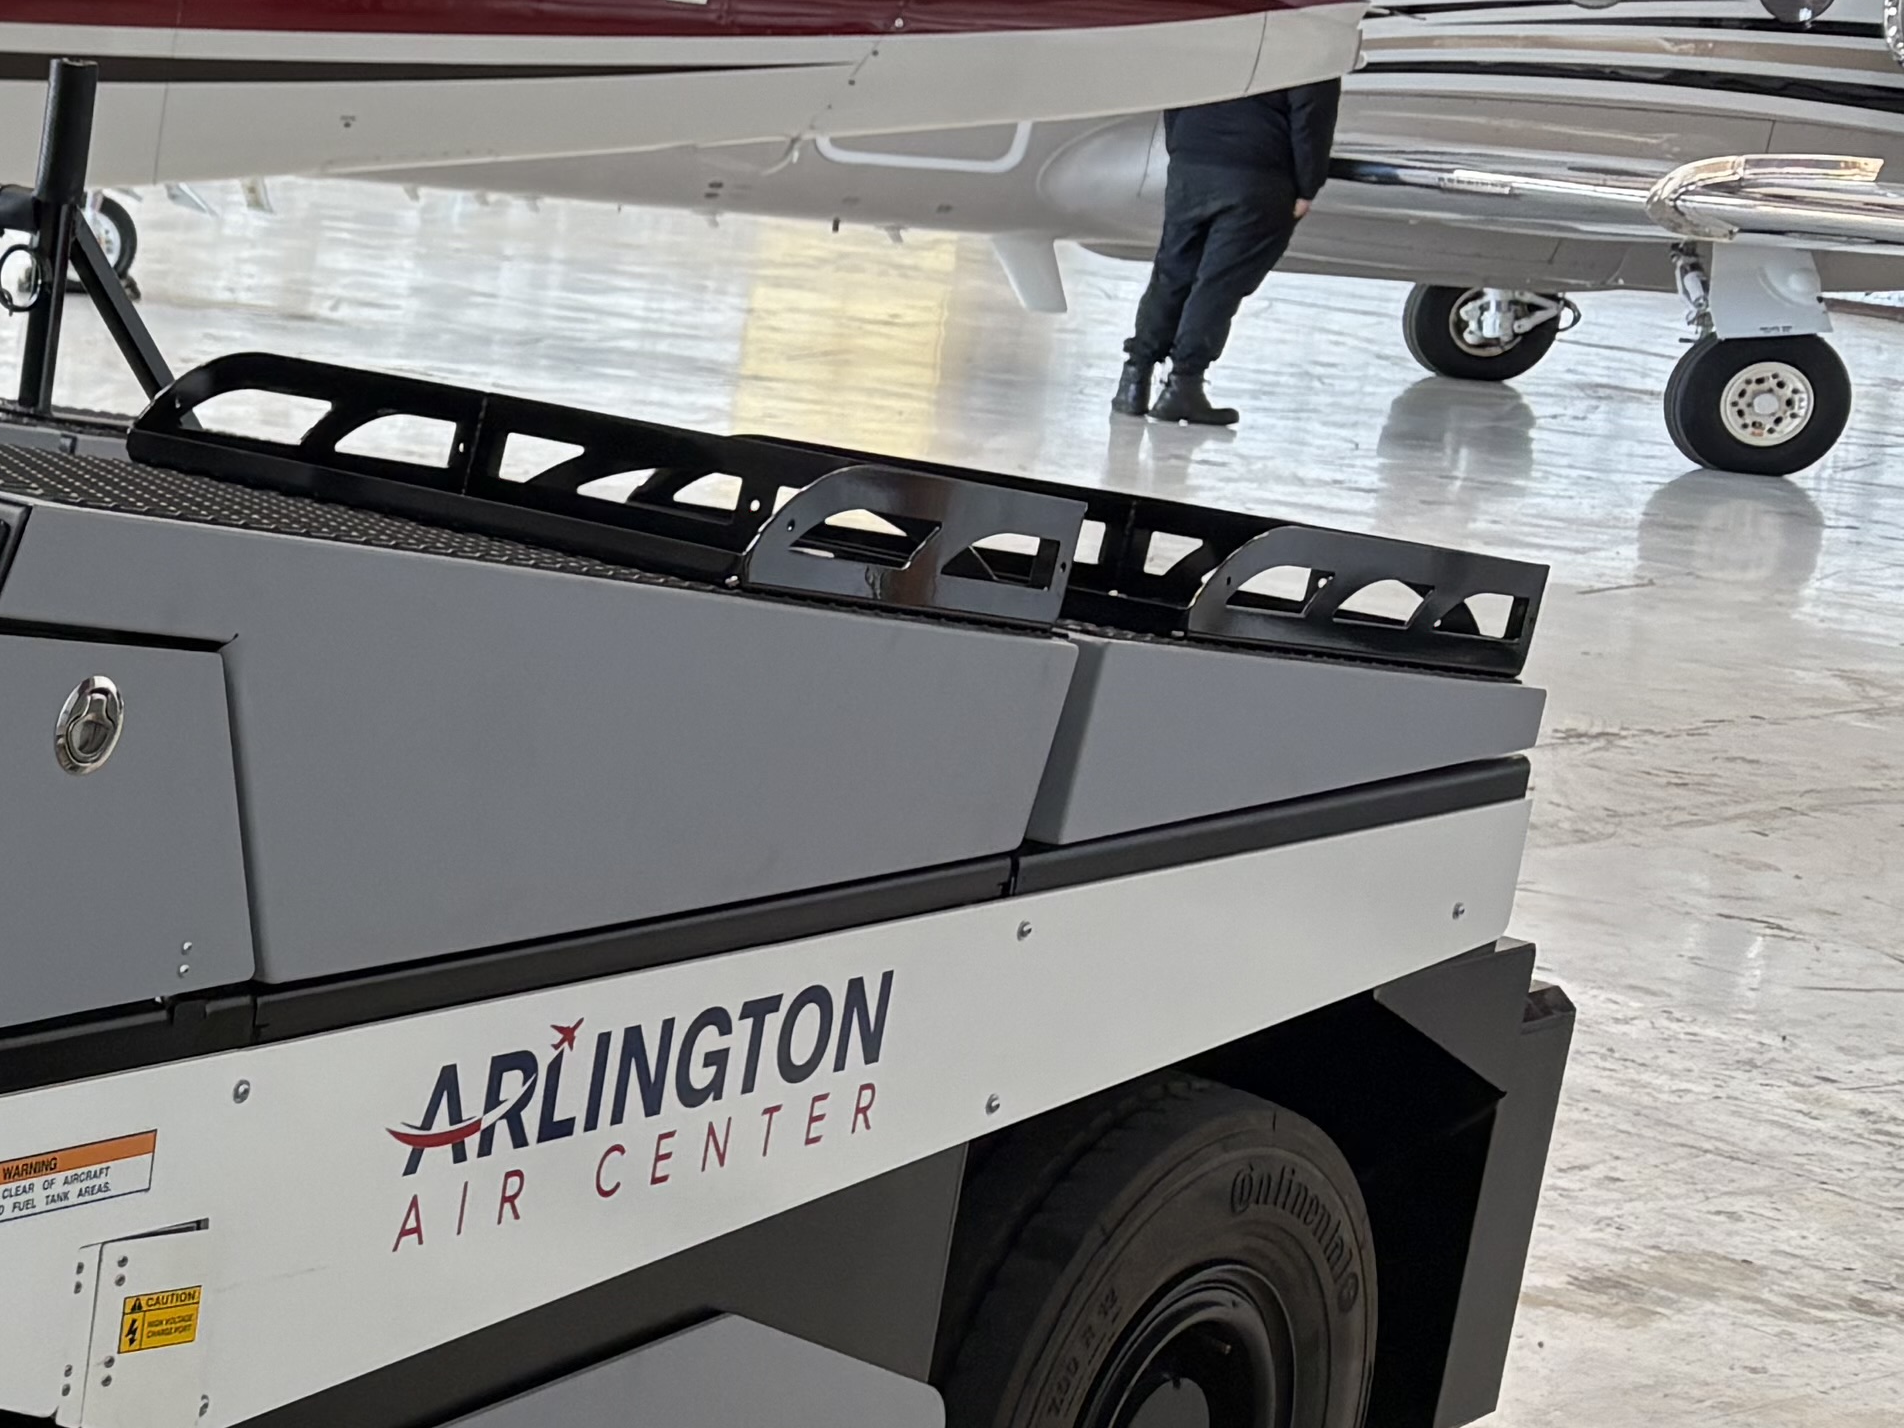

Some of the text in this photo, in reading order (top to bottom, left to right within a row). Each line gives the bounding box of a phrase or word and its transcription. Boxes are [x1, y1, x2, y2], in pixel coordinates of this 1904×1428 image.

[395, 970, 895, 1177] ARLINGTON
[2, 1157, 58, 1181] WARNING
[595, 1082, 877, 1198] CENTER
[2, 1183, 35, 1201] CLEAR
[42, 1178, 57, 1192] OF
[62, 1166, 111, 1187] AIRCRAFT
[11, 1198, 37, 1213] FUEL
[44, 1192, 70, 1206] TANK
[77, 1184, 111, 1200] AREAS.
[393, 1169, 525, 1253] AIR
[1230, 1162, 1353, 1285] Continental
[145, 1290, 197, 1308] CAUTION
